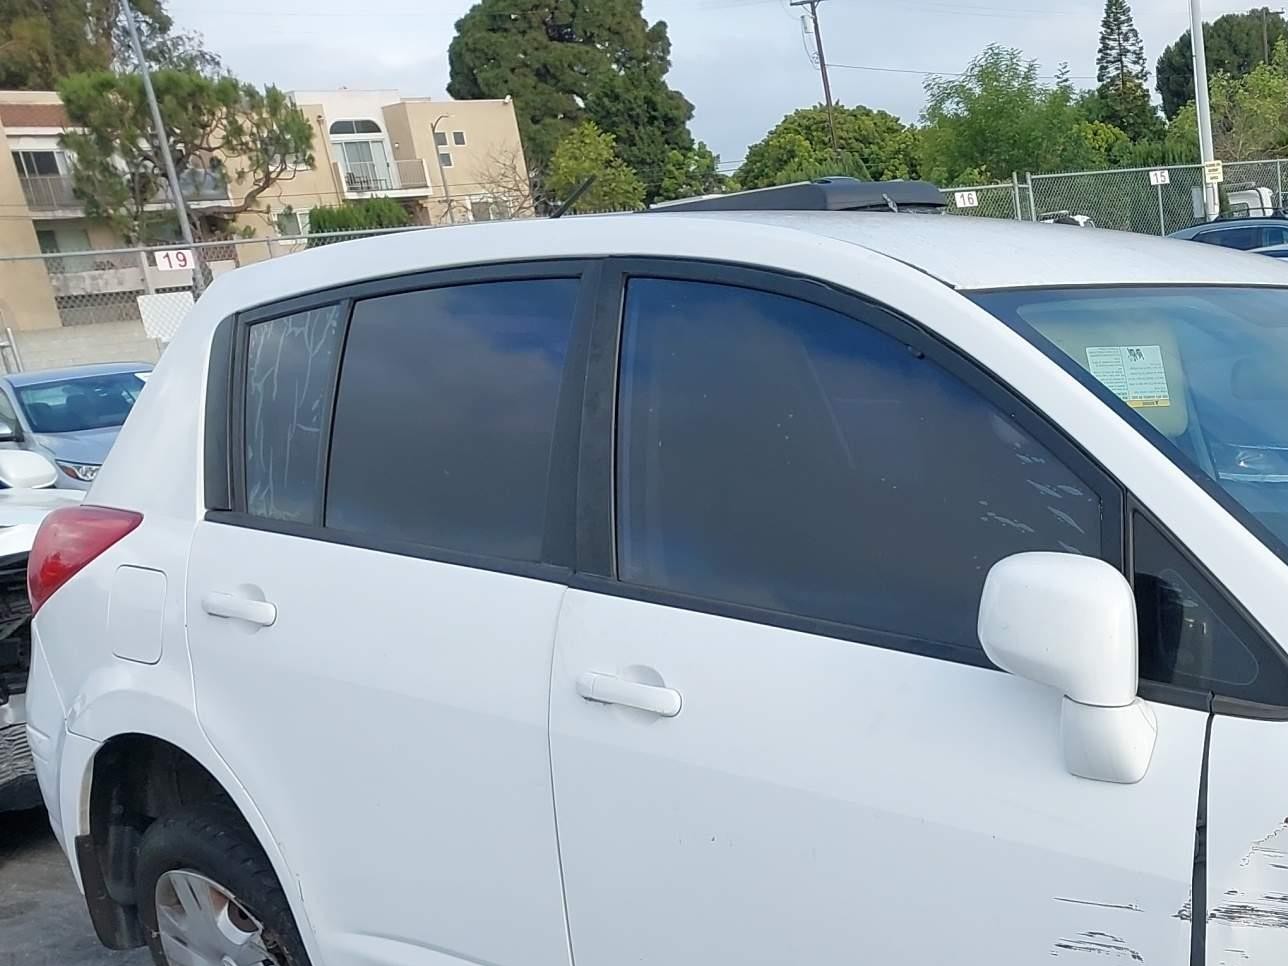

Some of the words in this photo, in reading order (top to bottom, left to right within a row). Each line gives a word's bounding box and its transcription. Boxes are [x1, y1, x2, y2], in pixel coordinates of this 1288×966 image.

[1153, 171, 1167, 184] 15
[960, 192, 975, 206] 16
[163, 251, 188, 269] 19
